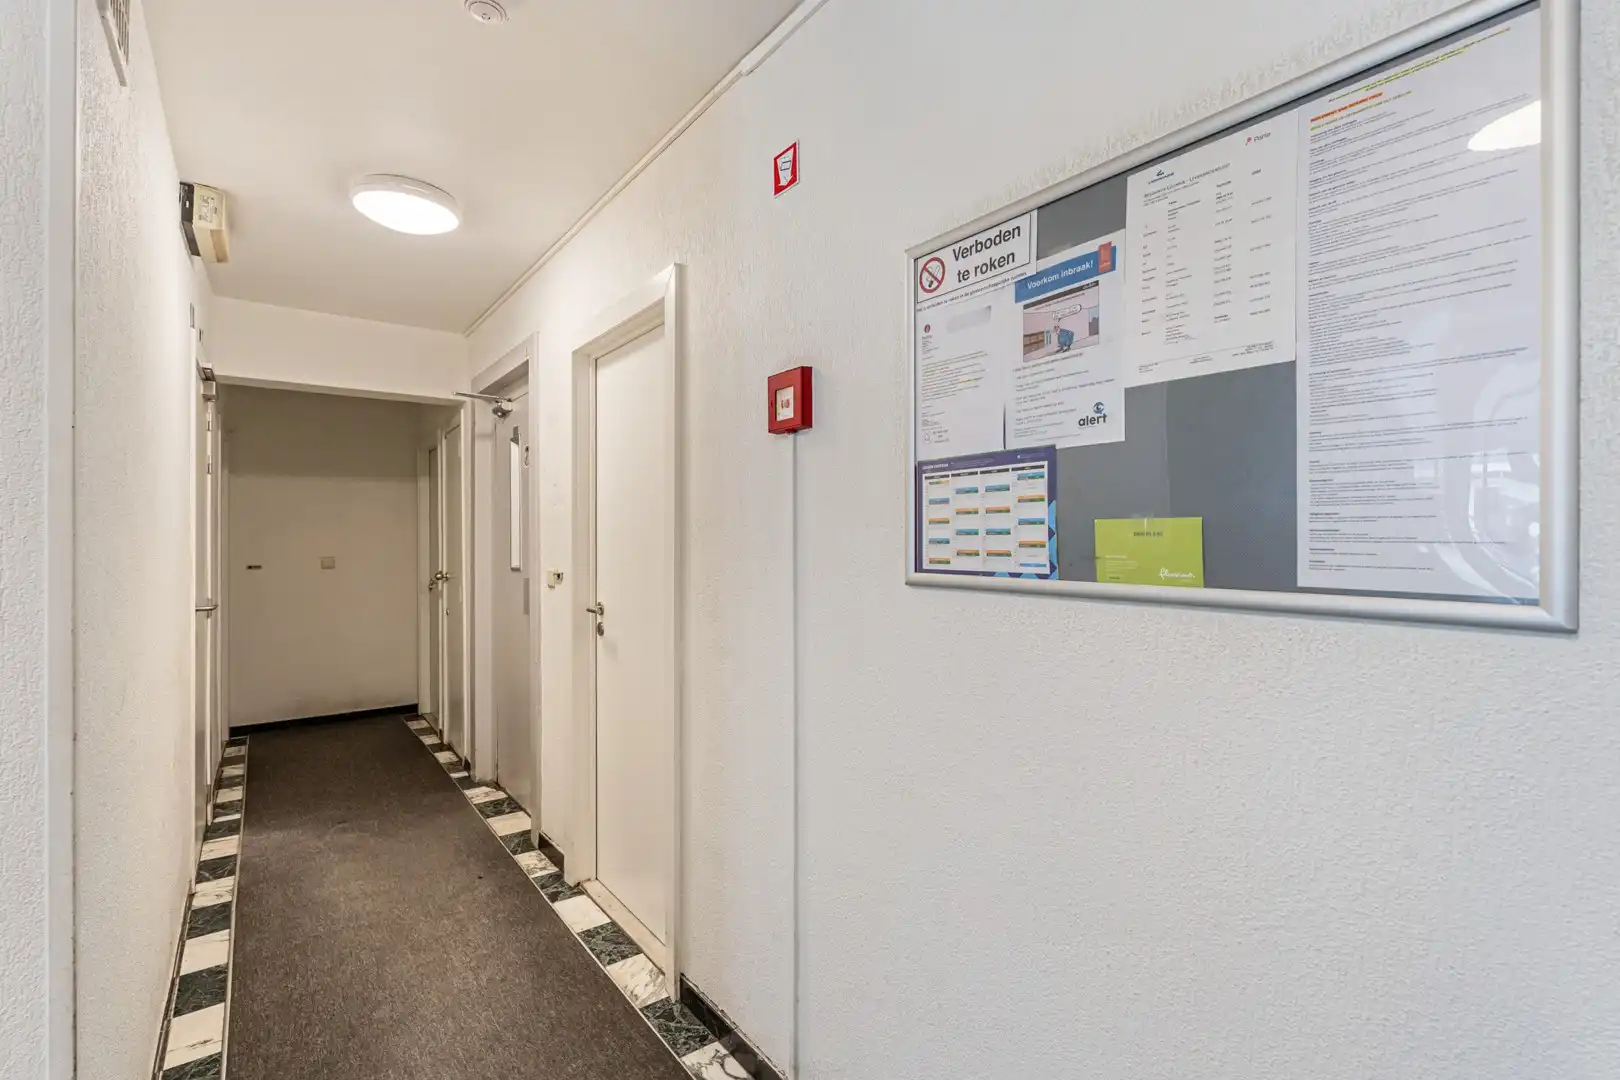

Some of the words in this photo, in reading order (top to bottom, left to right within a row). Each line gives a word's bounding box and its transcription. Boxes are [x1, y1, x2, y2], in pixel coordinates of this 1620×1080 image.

[952, 225, 1021, 262] Verboden
[957, 268, 970, 283] te
[974, 252, 1015, 277] roken
[1027, 272, 1060, 291] Voorkom
[1060, 260, 1094, 278] inbraak!
[1078, 412, 1107, 427] alert
